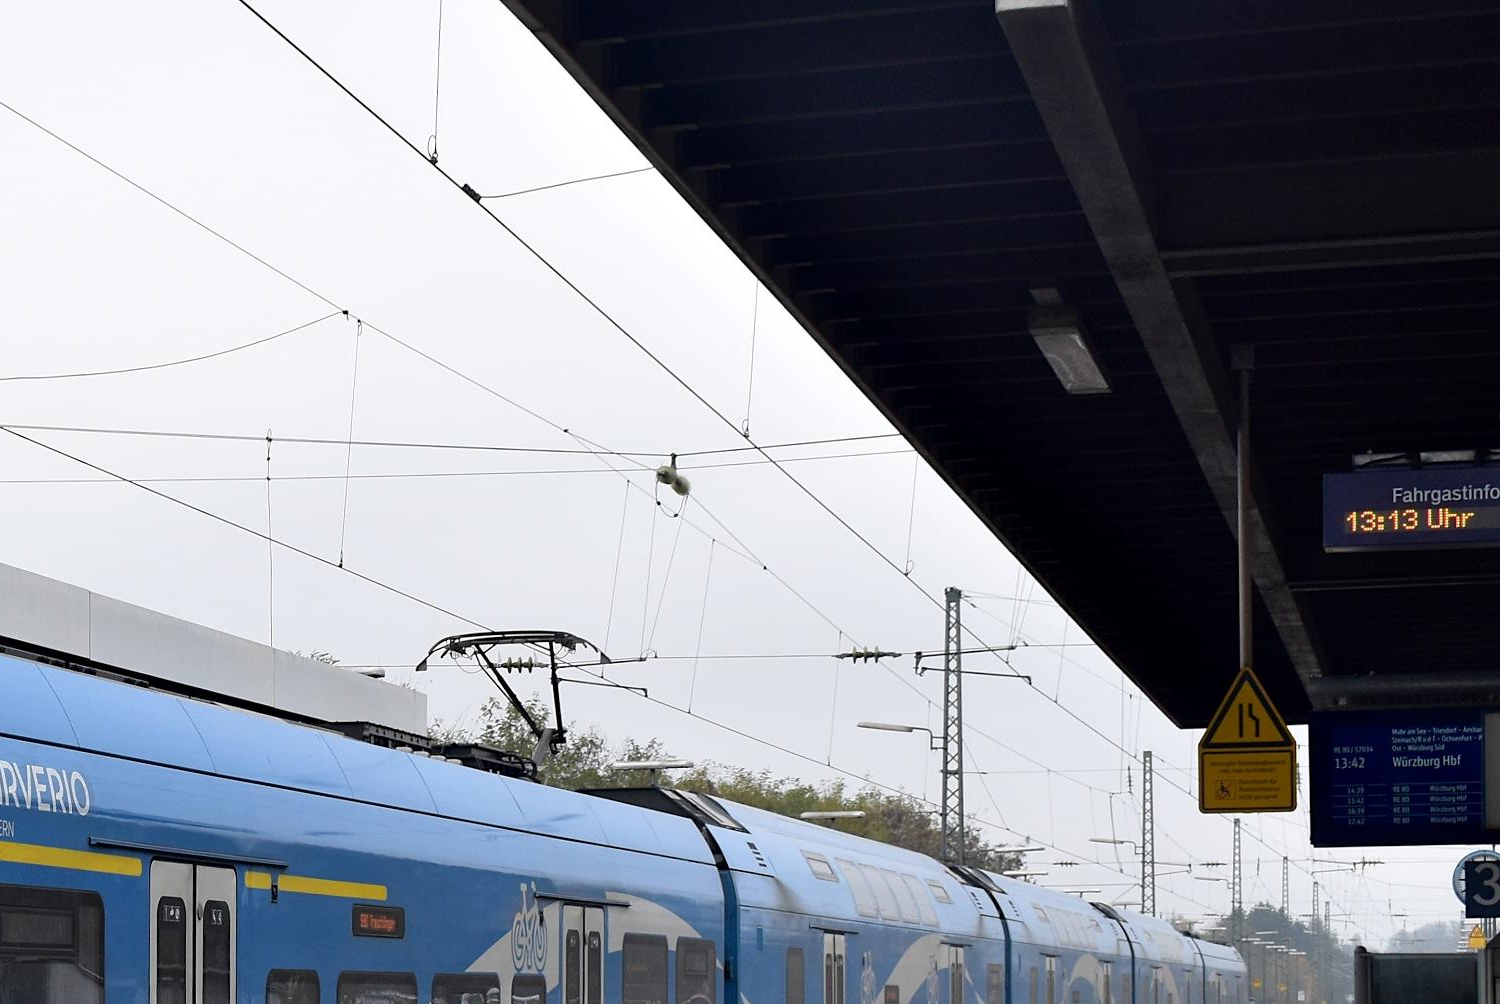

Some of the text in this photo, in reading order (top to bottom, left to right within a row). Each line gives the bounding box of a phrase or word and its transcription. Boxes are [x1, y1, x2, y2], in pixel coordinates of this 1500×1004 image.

[1346, 508, 1475, 532] 13:13 Uhr
[1335, 757, 1365, 769] 13:42
[1392, 754, 1462, 769] Würzburg Hbf
[1473, 862, 1500, 906] 3
